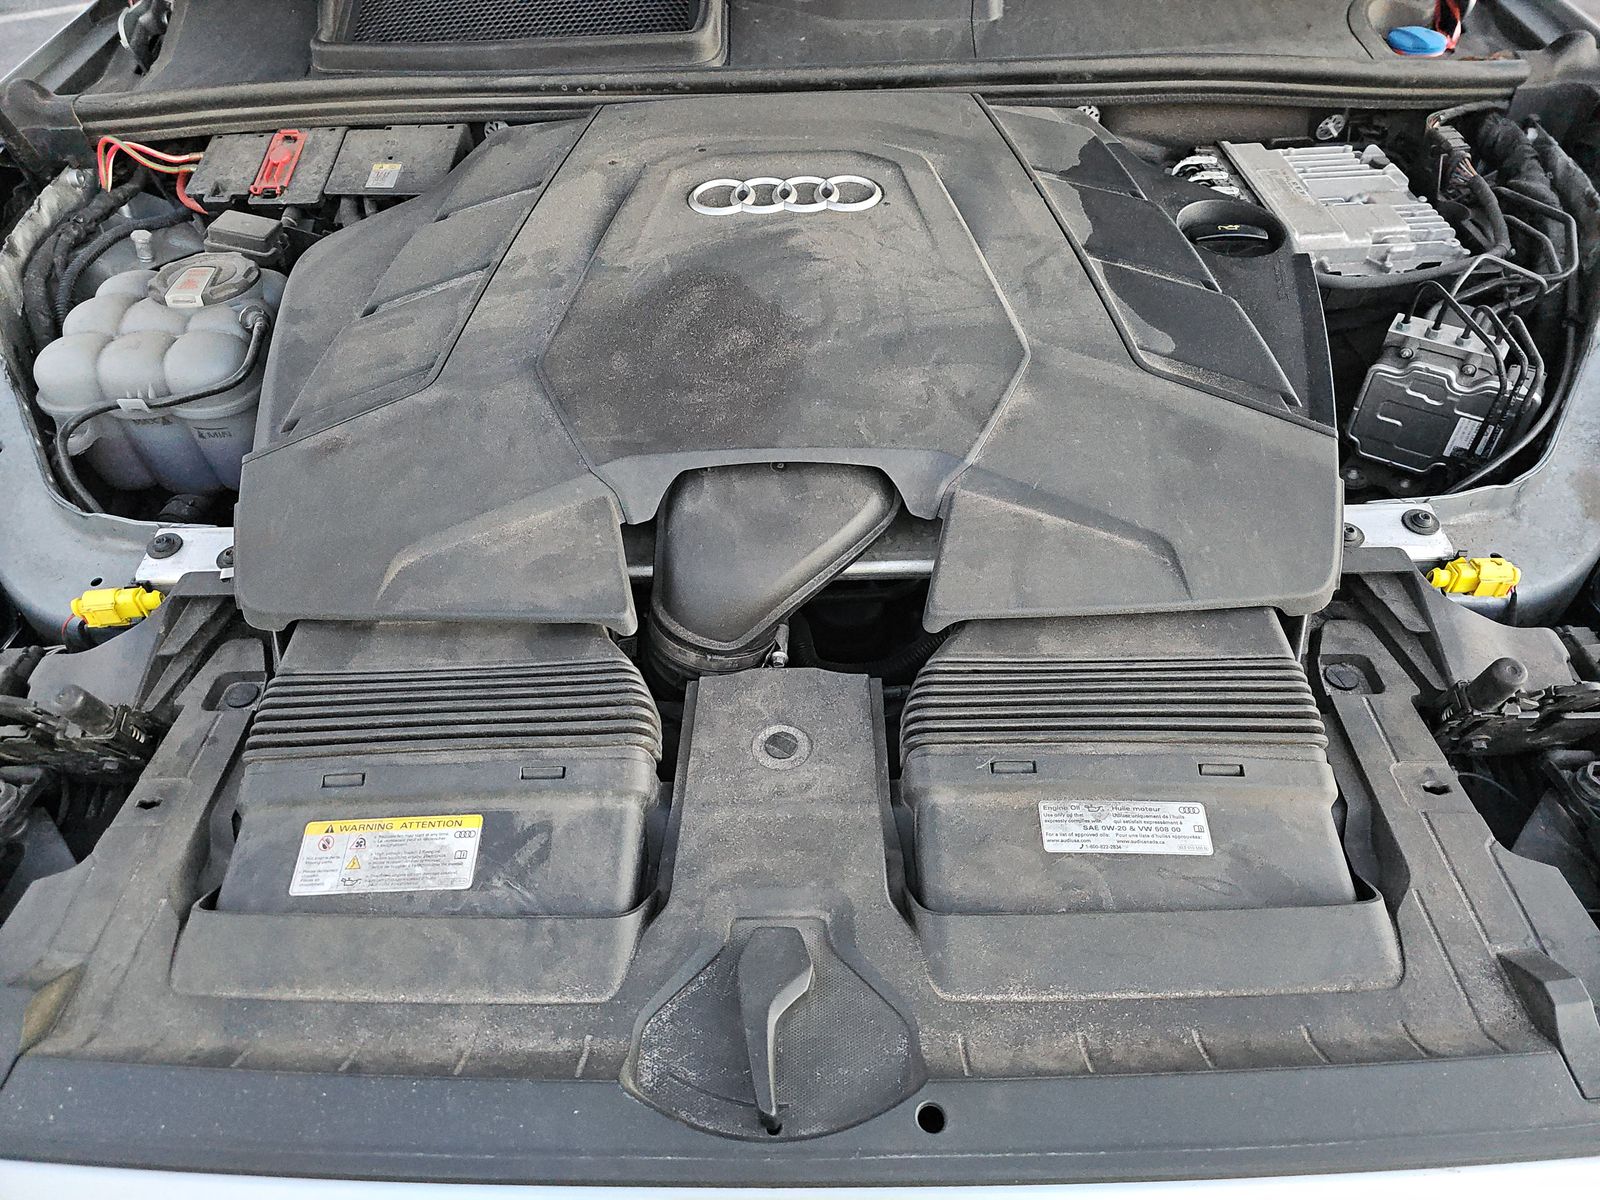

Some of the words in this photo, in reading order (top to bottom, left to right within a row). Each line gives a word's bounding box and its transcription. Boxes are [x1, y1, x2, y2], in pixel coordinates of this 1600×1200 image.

[1043, 804, 1068, 812] Engine
[339, 822, 394, 832] WARNING
[399, 819, 464, 829] ATTENTION
